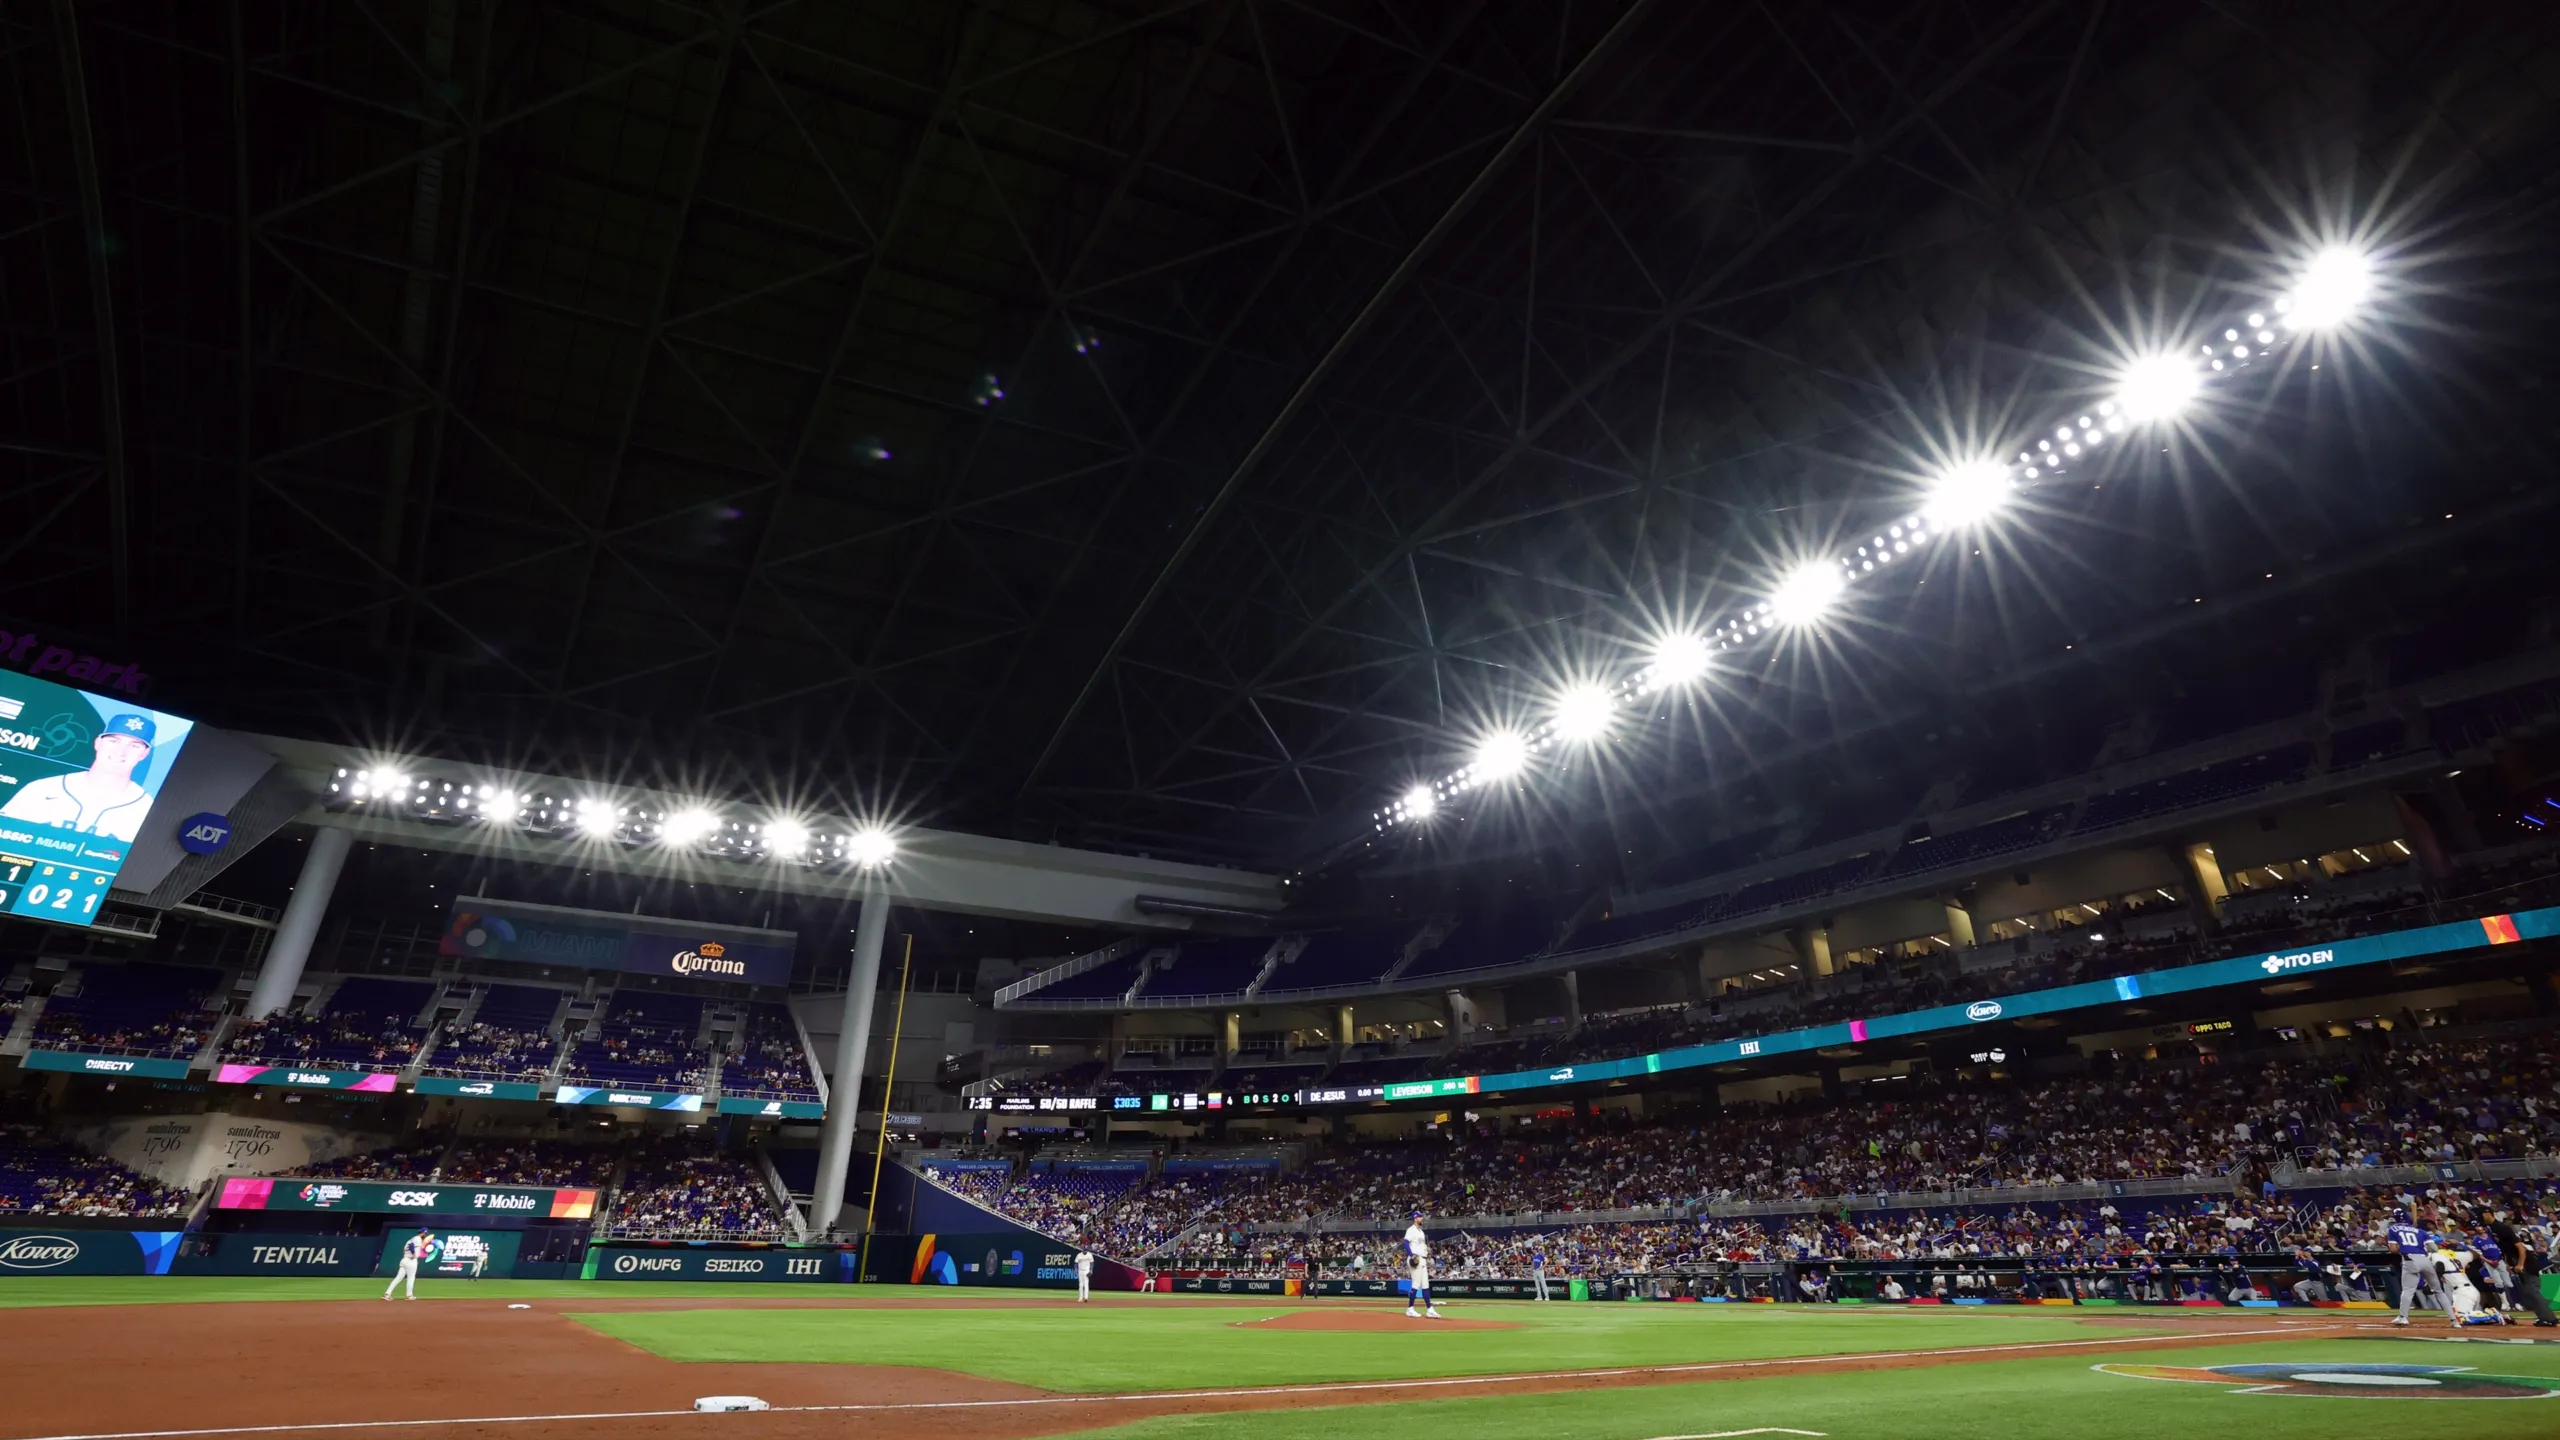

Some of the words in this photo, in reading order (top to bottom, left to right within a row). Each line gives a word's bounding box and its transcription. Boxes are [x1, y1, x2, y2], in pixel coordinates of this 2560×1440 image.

[28, 645, 150, 694] park
[186, 825, 228, 845] ADT
[35, 836, 77, 852] MIAMI
[1, 855, 34, 867] ERRORS
[8, 865, 21, 882] 1
[42, 866, 55, 876] B
[69, 871, 80, 881] S
[94, 876, 106, 885] O
[28, 884, 49, 905] 0
[51, 888, 73, 909] 2
[83, 893, 98, 913] 1
[520, 930, 620, 962] MIAMI
[671, 950, 745, 976] Corona
[2284, 953, 2312, 967] ITO
[2312, 950, 2334, 964] EN
[1968, 1003, 2001, 1017] Kowa
[2195, 1023, 2213, 1033] OPPO
[2214, 1021, 2233, 1030] TACO
[1739, 1041, 1760, 1055] IHI
[85, 1058, 134, 1072] DIRECTV
[298, 1073, 330, 1085] Mobile
[1244, 1096, 1250, 1104] B
[1252, 1094, 1259, 1104] 0
[1262, 1094, 1269, 1103] S
[1272, 1093, 1279, 1103] 2
[1294, 1092, 1299, 1102] 1
[1310, 1092, 1321, 1102] DE
[1321, 1090, 1346, 1100] JESUS
[1357, 1089, 1372, 1097] 0.00
[1391, 1084, 1434, 1098] LEVENSON
[969, 1097, 993, 1110] 7:35
[1039, 1097, 1068, 1111] 50/50
[1069, 1098, 1097, 1109] RAFFLE
[1114, 1098, 1141, 1109] $3035
[1173, 1098, 1180, 1108] 0
[1227, 1096, 1233, 1106] 4
[143, 1135, 181, 1158] 1796
[225, 1139, 271, 1160] 1796
[2442, 1168, 2454, 1179] 10
[2114, 1185, 2122, 1194] 9
[388, 1190, 439, 1207] SCSK
[488, 1194, 536, 1210] Mobile
[447, 1235, 480, 1243] WORLD
[2398, 1231, 2419, 1246] 10
[0, 1240, 75, 1260] Kowa
[252, 1246, 339, 1264] TENTIAL
[639, 1258, 682, 1271] MUFG
[704, 1259, 764, 1272] SEIKO
[786, 1258, 822, 1275] IHI
[1045, 1254, 1072, 1266] EXPECT
[1248, 1282, 1270, 1290] KONAMI
